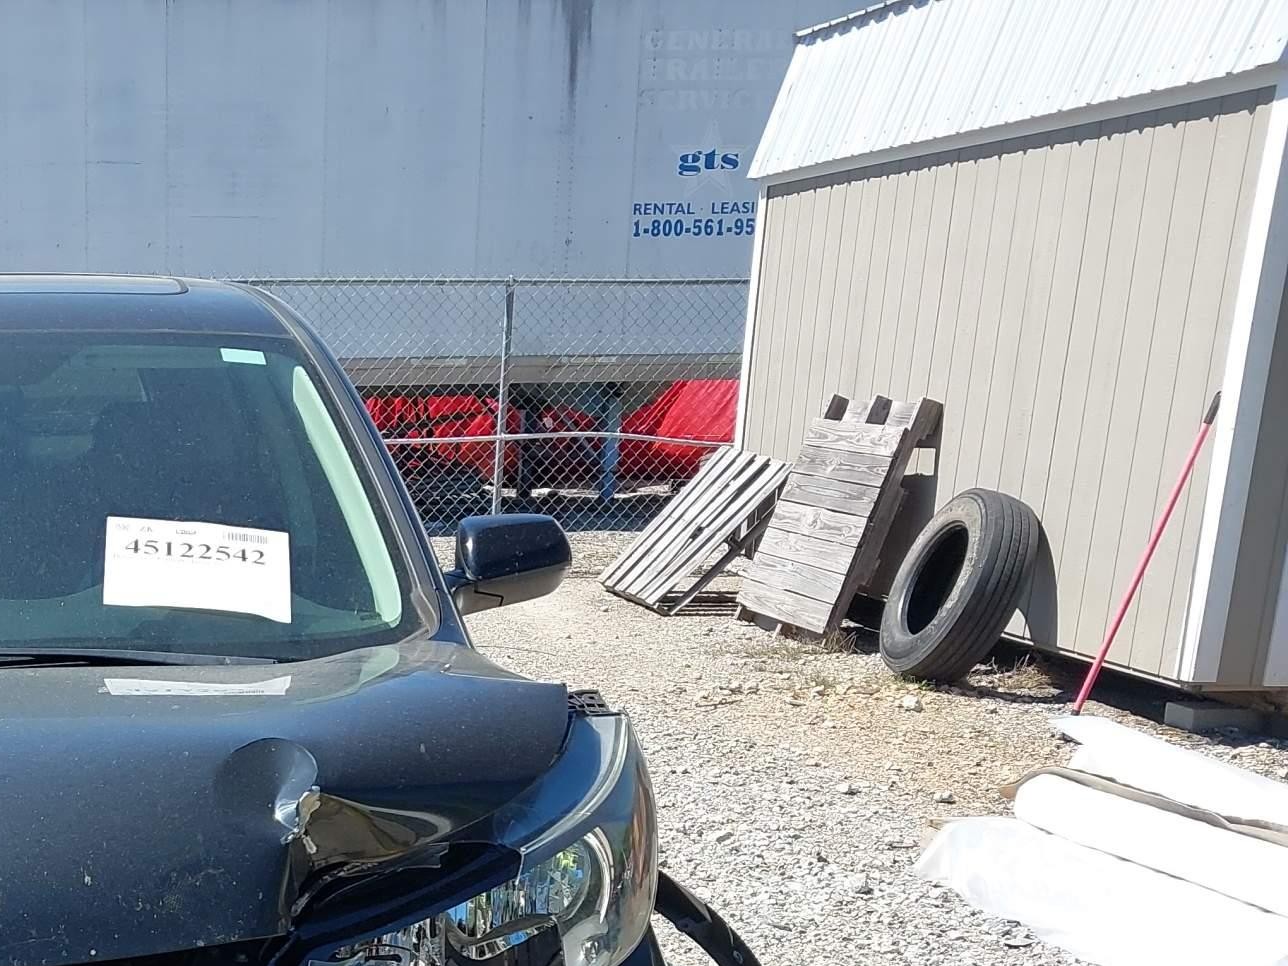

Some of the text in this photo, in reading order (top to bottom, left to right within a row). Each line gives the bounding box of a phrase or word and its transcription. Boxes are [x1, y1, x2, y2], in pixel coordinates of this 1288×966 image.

[678, 148, 740, 176] gts
[633, 202, 695, 215] RENTAL
[633, 218, 755, 237] 1-800-561-95
[125, 538, 266, 565] 45122542
